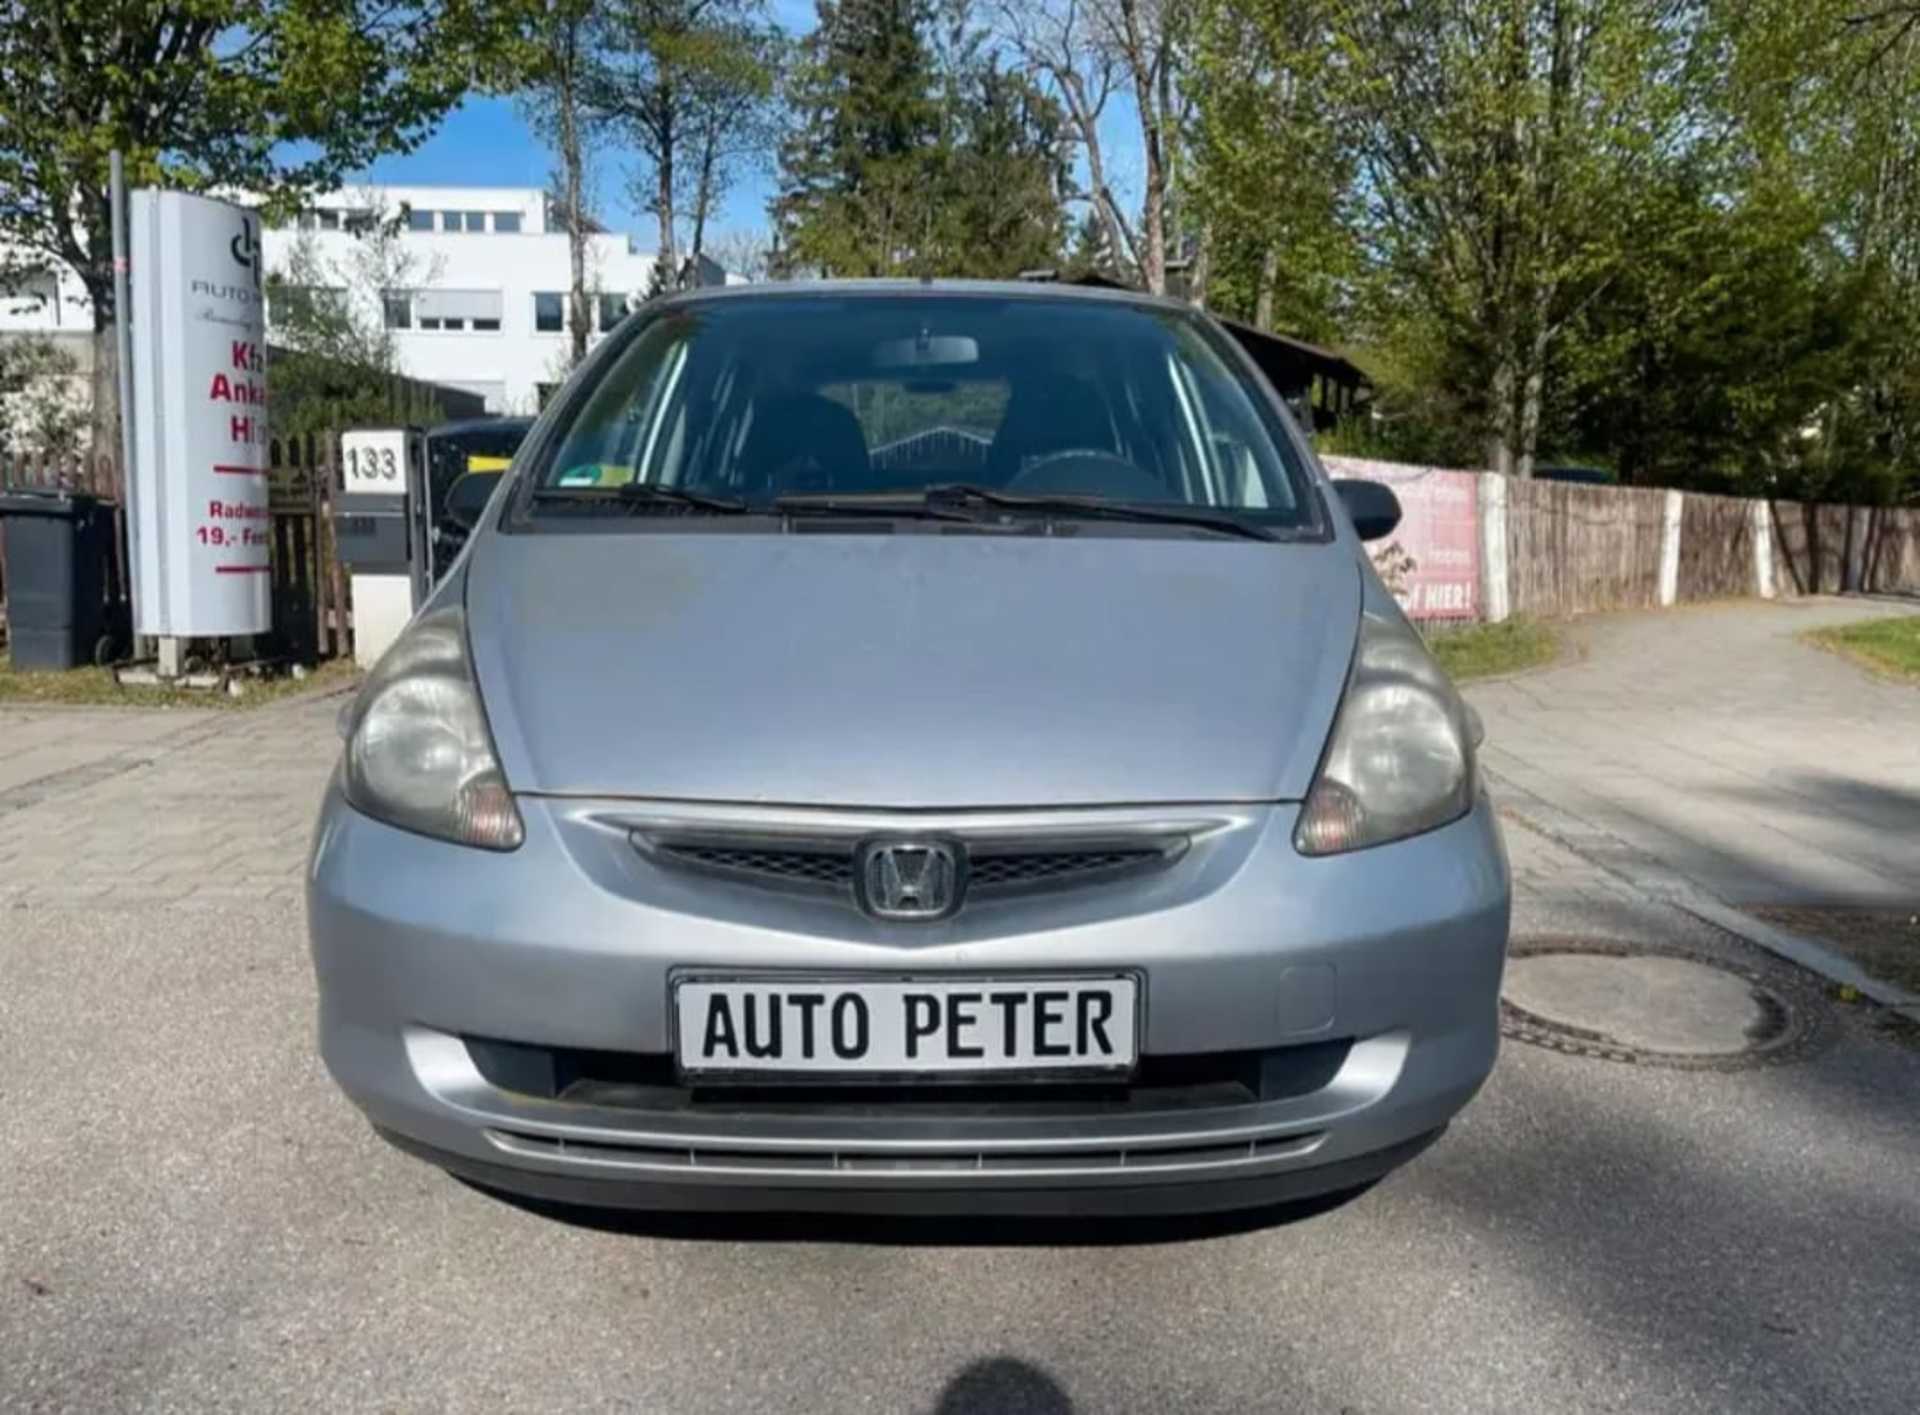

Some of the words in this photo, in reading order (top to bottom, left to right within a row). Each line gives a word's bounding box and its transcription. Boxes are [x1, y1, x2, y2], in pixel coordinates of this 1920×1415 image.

[192, 281, 249, 304] AUTO
[346, 447, 396, 480] 133
[702, 992, 869, 1059] AUTO
[903, 990, 1113, 1059] PETER
